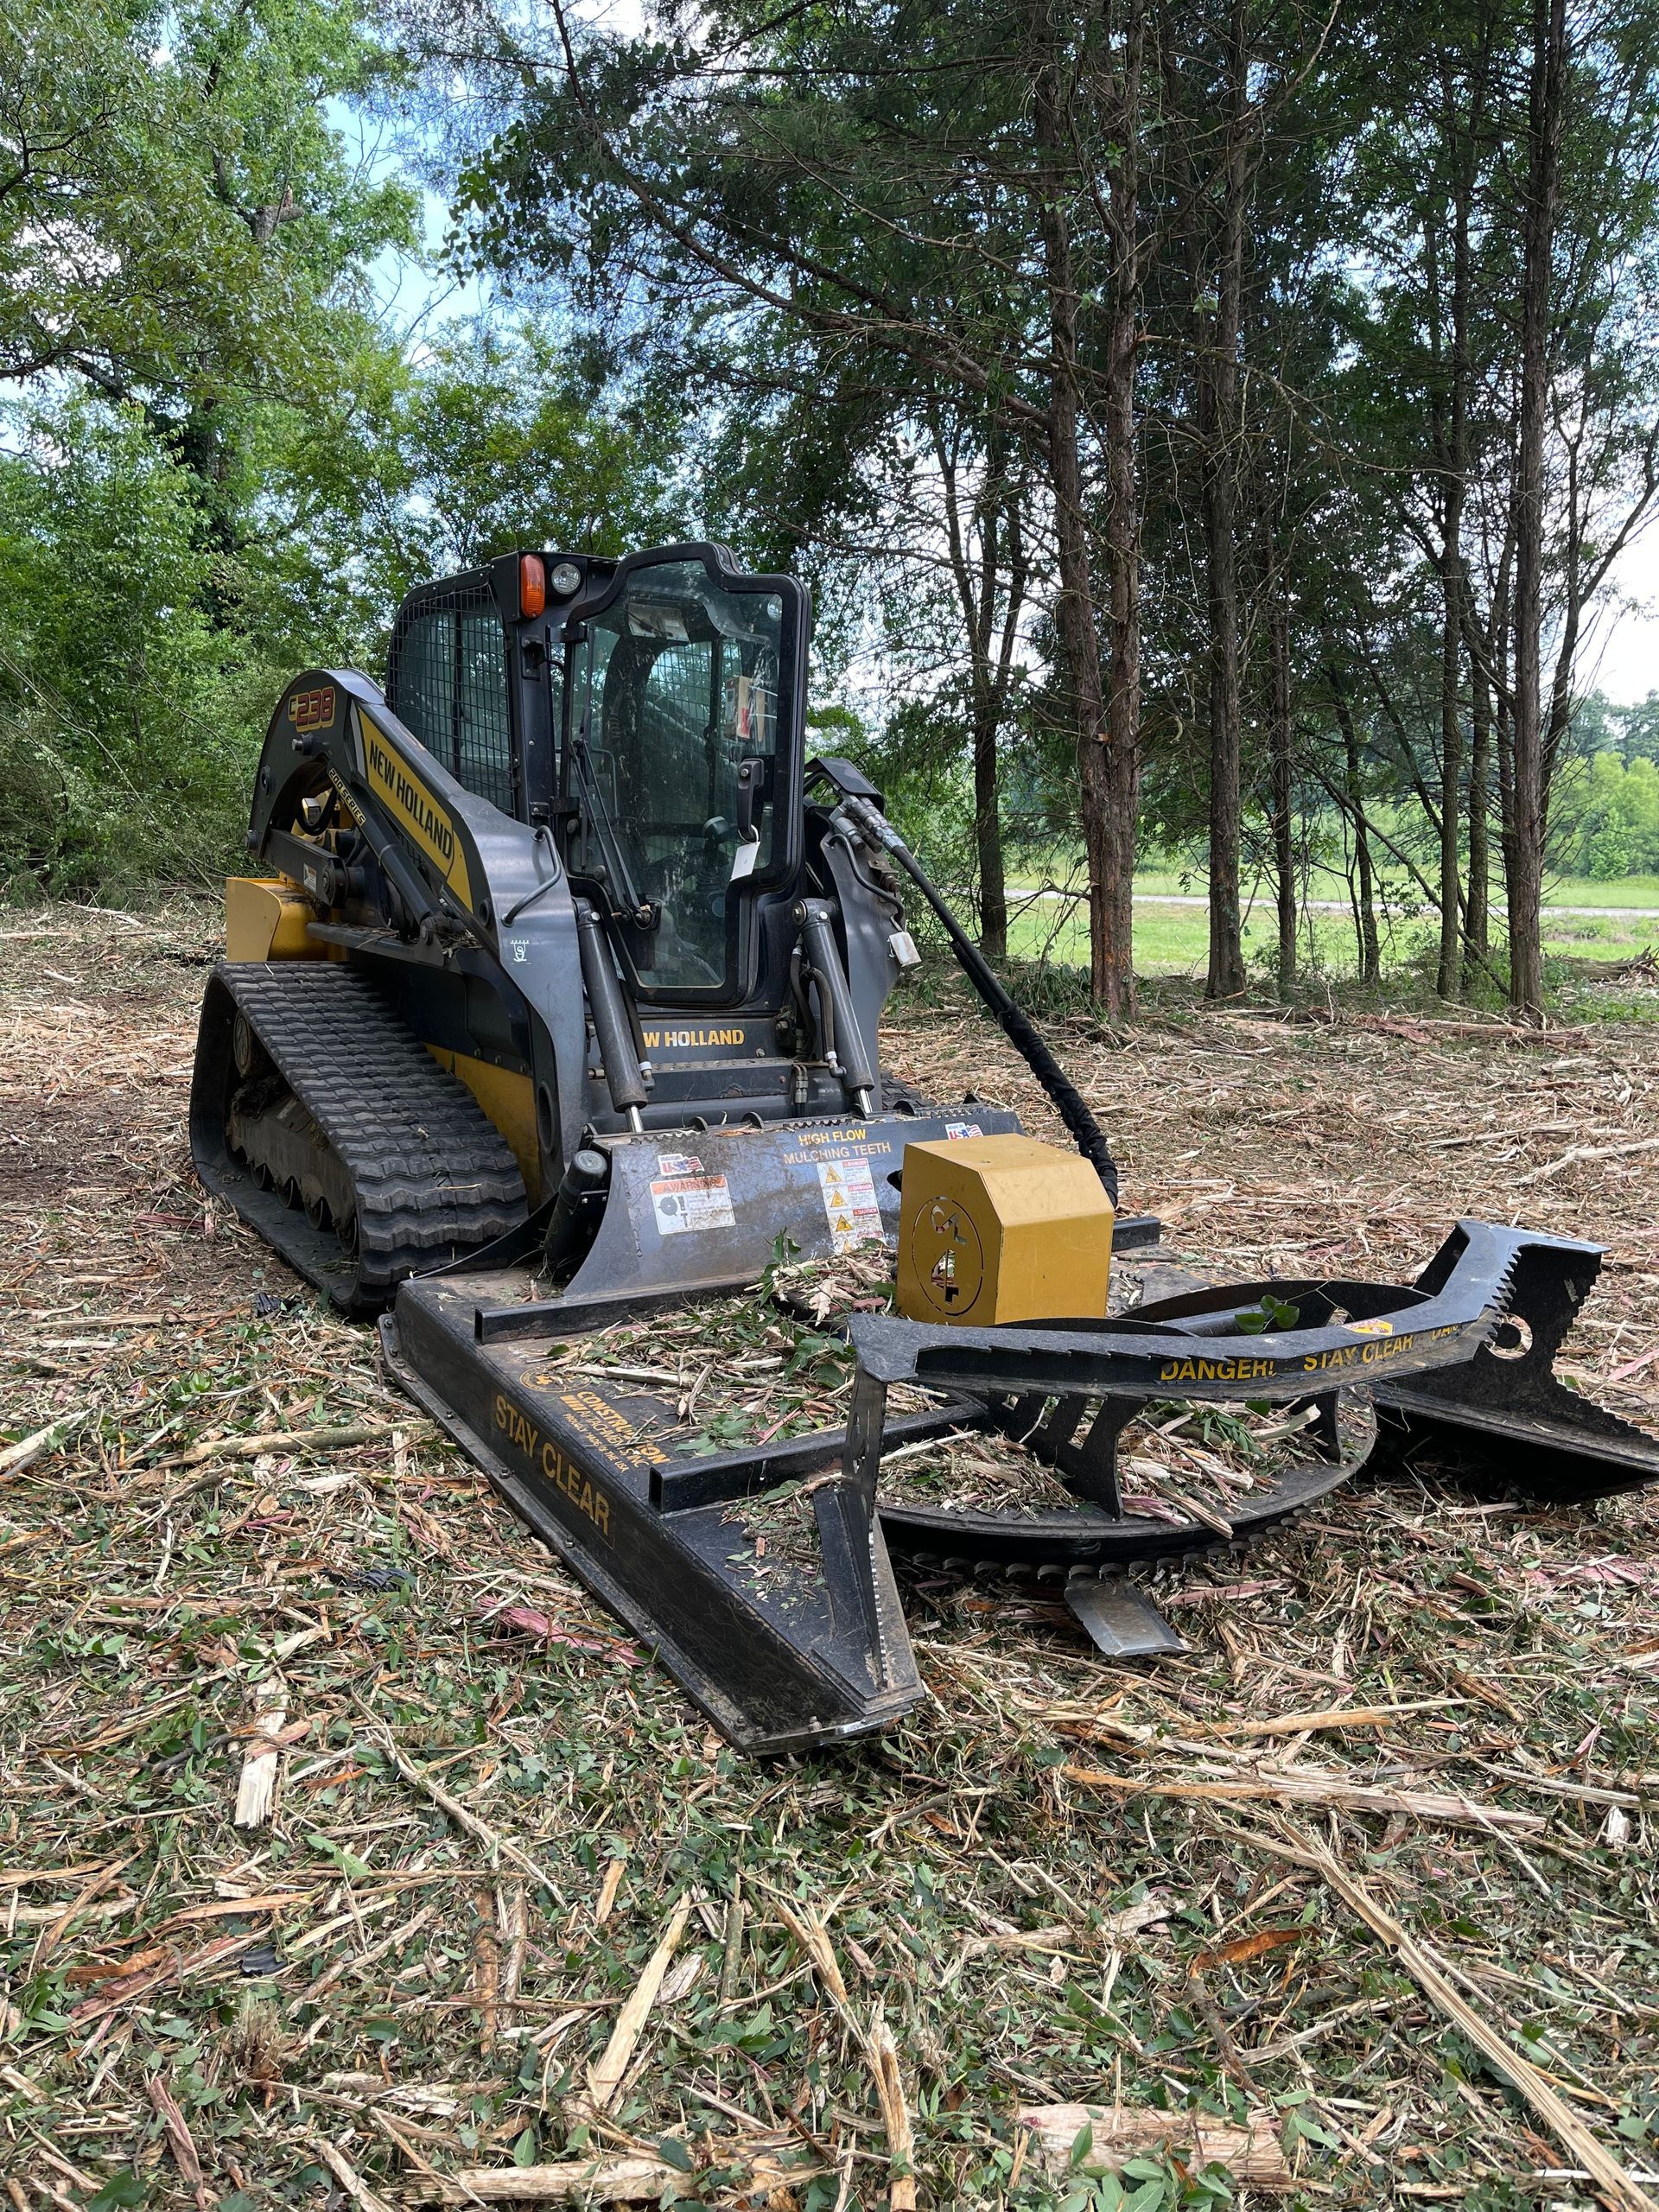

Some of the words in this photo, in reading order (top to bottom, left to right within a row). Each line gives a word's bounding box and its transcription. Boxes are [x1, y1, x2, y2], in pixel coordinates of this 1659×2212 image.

[329, 768, 344, 790] 200
[340, 789, 365, 824] SERIES
[369, 739, 396, 791] NEW
[396, 772, 453, 860] HOLLAND
[664, 1029, 745, 1047] HOLLAND
[783, 1146, 850, 1165] MULCHING
[851, 1141, 892, 1157] TEETH
[798, 1131, 830, 1147] HIGH
[832, 1128, 867, 1141] FLOW
[1160, 1358, 1274, 1381] DANGER!
[1303, 1345, 1357, 1372] STAY
[1362, 1334, 1414, 1363] CLEAR
[495, 1395, 538, 1459] STAY
[542, 1442, 610, 1536] CLEAR
[614, 1460, 630, 1472] USA
